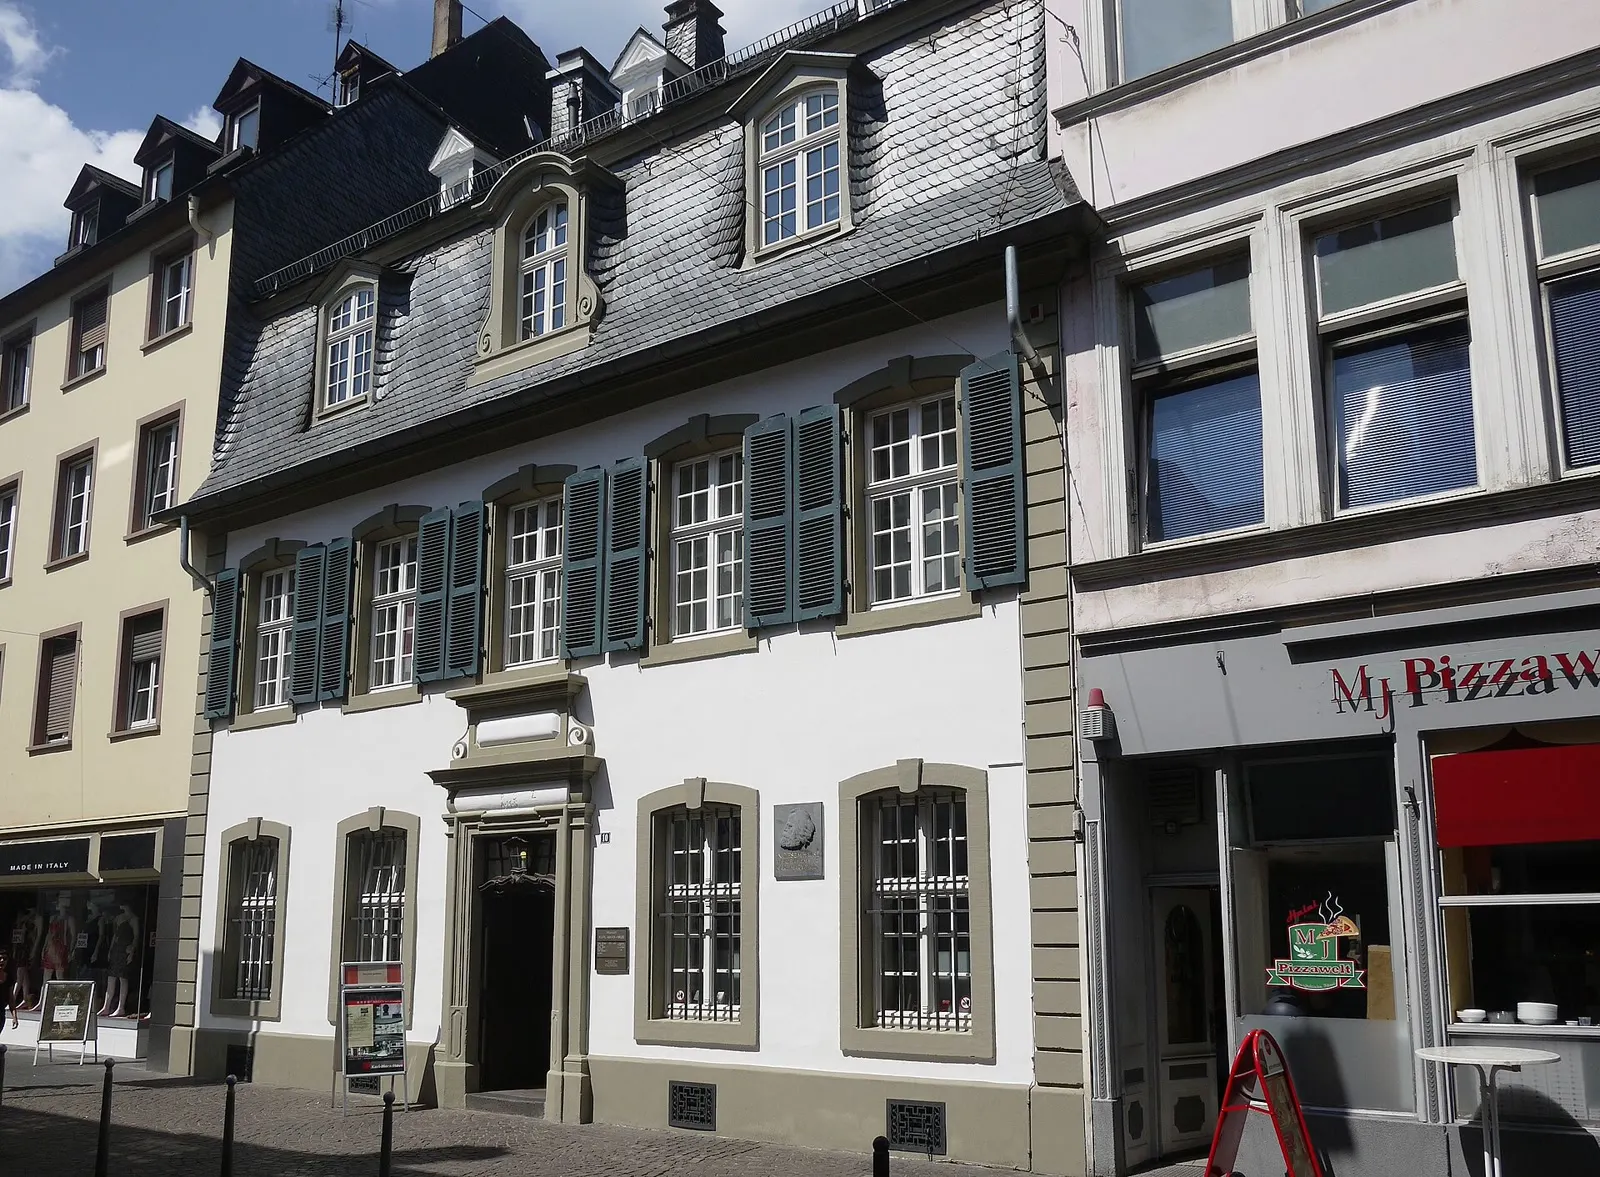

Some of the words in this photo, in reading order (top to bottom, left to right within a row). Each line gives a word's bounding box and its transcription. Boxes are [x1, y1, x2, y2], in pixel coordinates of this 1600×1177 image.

[1329, 664, 1391, 720] MJ
[601, 833, 610, 842] 10
[10, 863, 31, 871] MADE
[46, 861, 68, 869] ITALY
[1278, 963, 1352, 974] Pizzawelt
